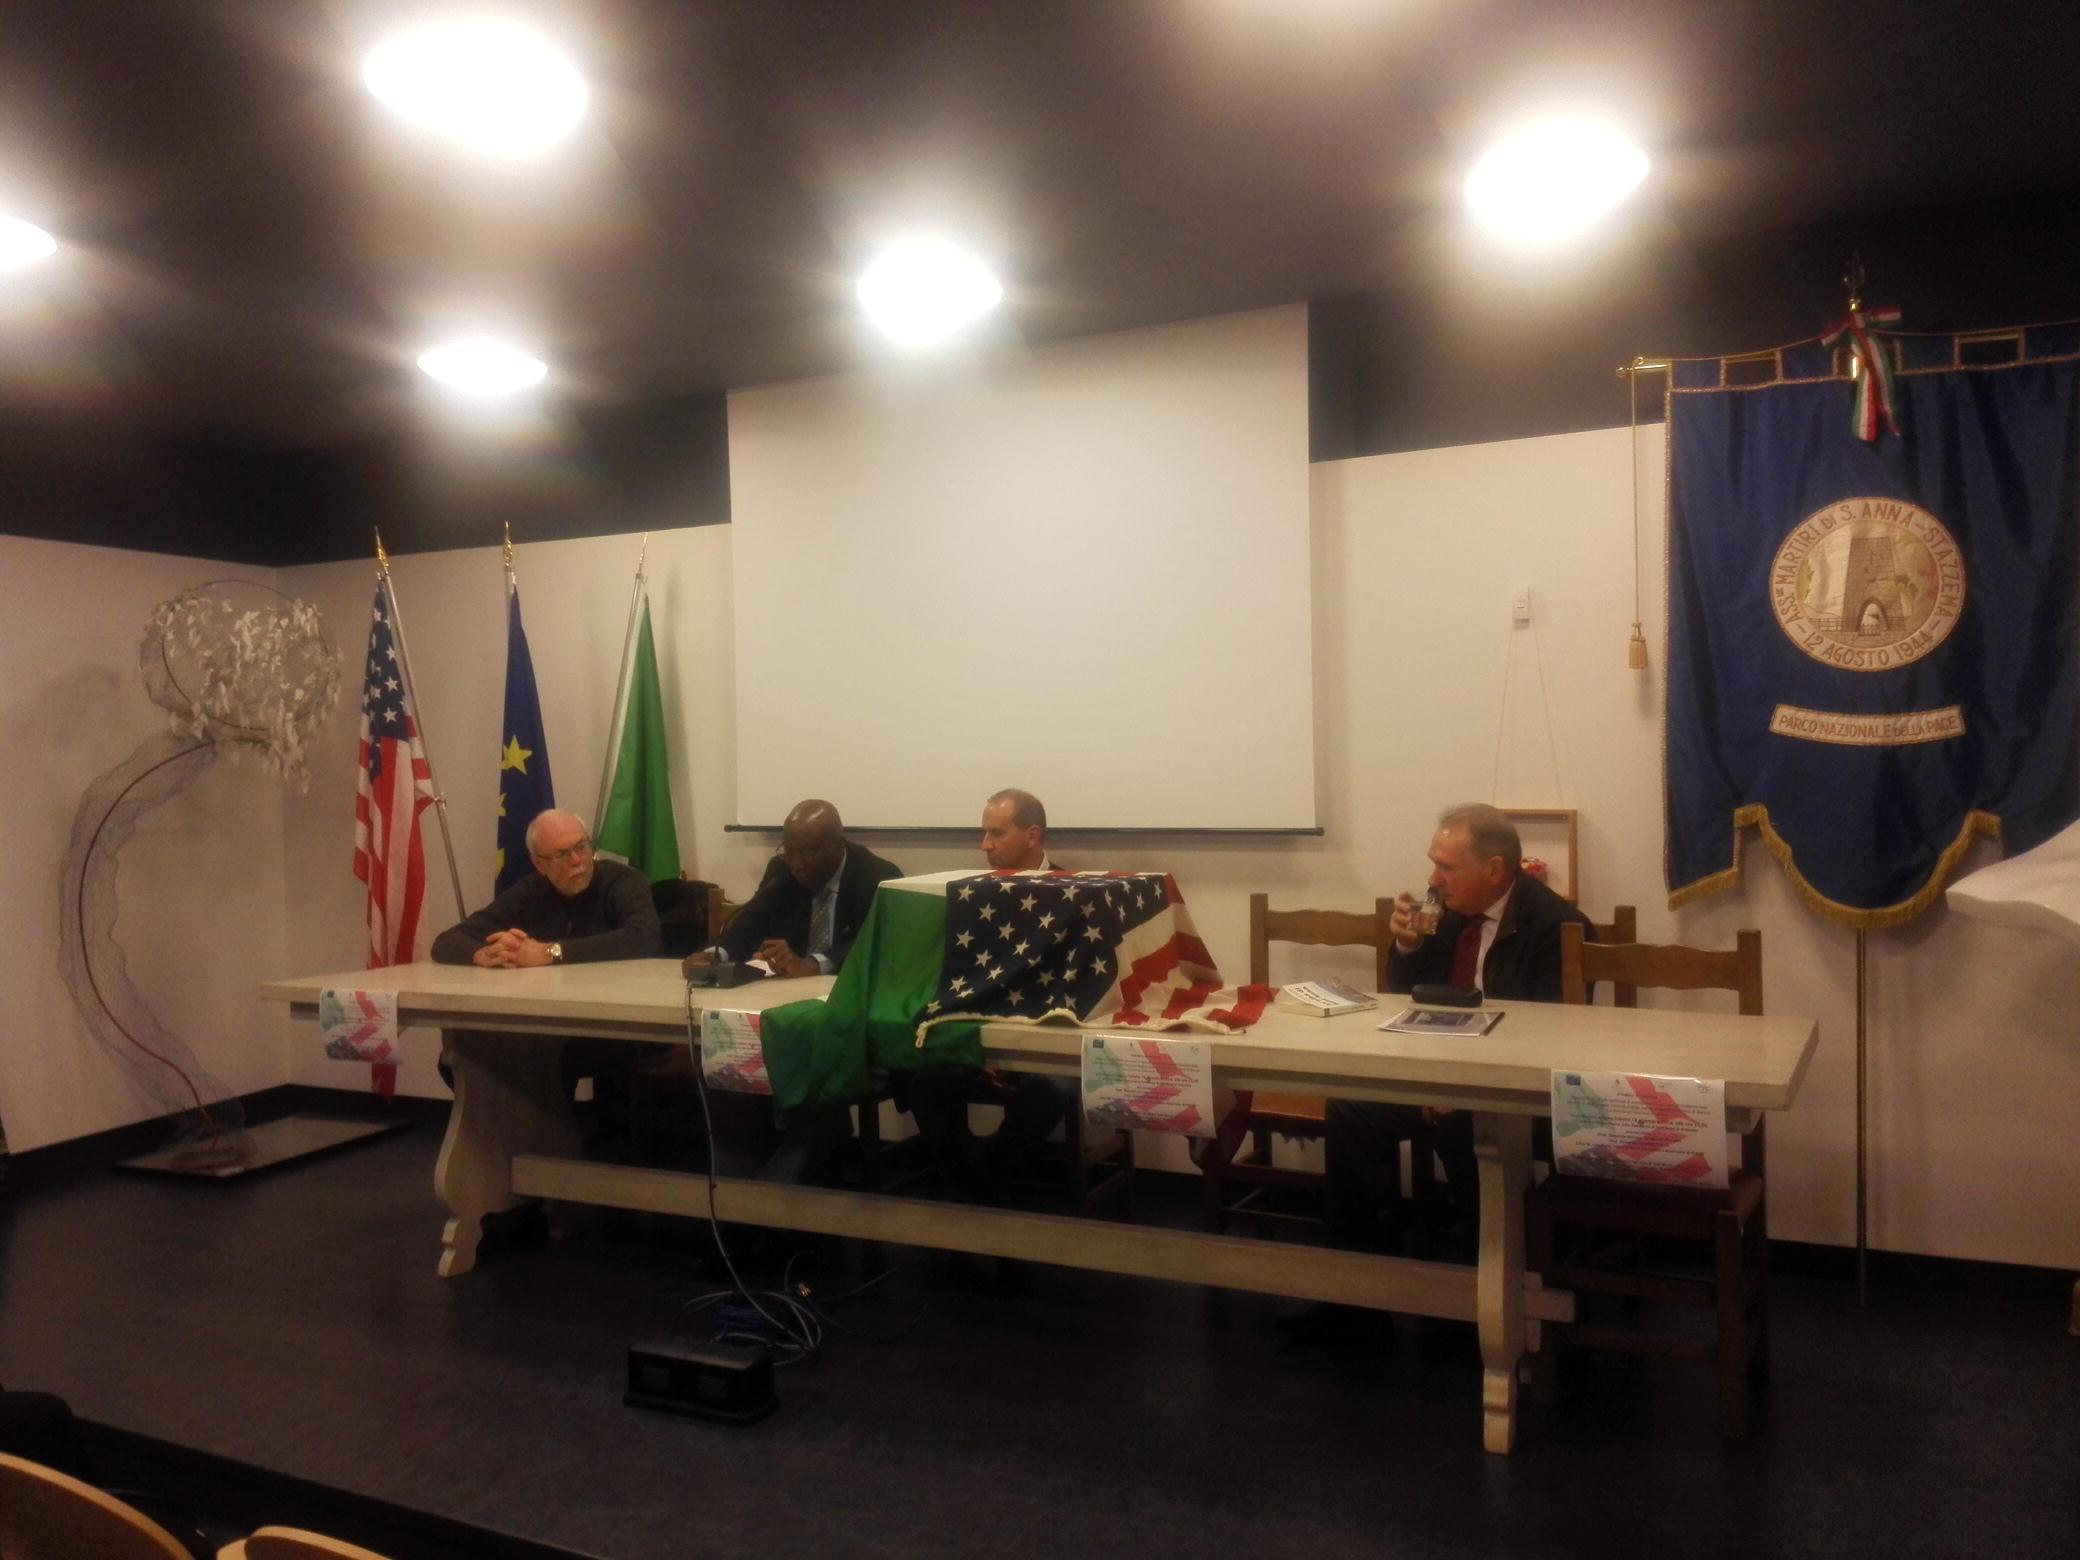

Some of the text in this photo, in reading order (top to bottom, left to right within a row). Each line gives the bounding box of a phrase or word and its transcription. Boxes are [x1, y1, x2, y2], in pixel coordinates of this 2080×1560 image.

[1776, 524, 1820, 585] MARTIRI
[1840, 504, 1856, 520] S.
[1862, 502, 1914, 529] ANNA
[1922, 527, 1962, 618] STAZZEMA
[1802, 631, 1935, 667] 12 AGOSTO 1944
[1780, 715, 1818, 733] PARCO
[1821, 722, 1891, 738] NAZIONALE
[1927, 716, 1958, 732] PACE
